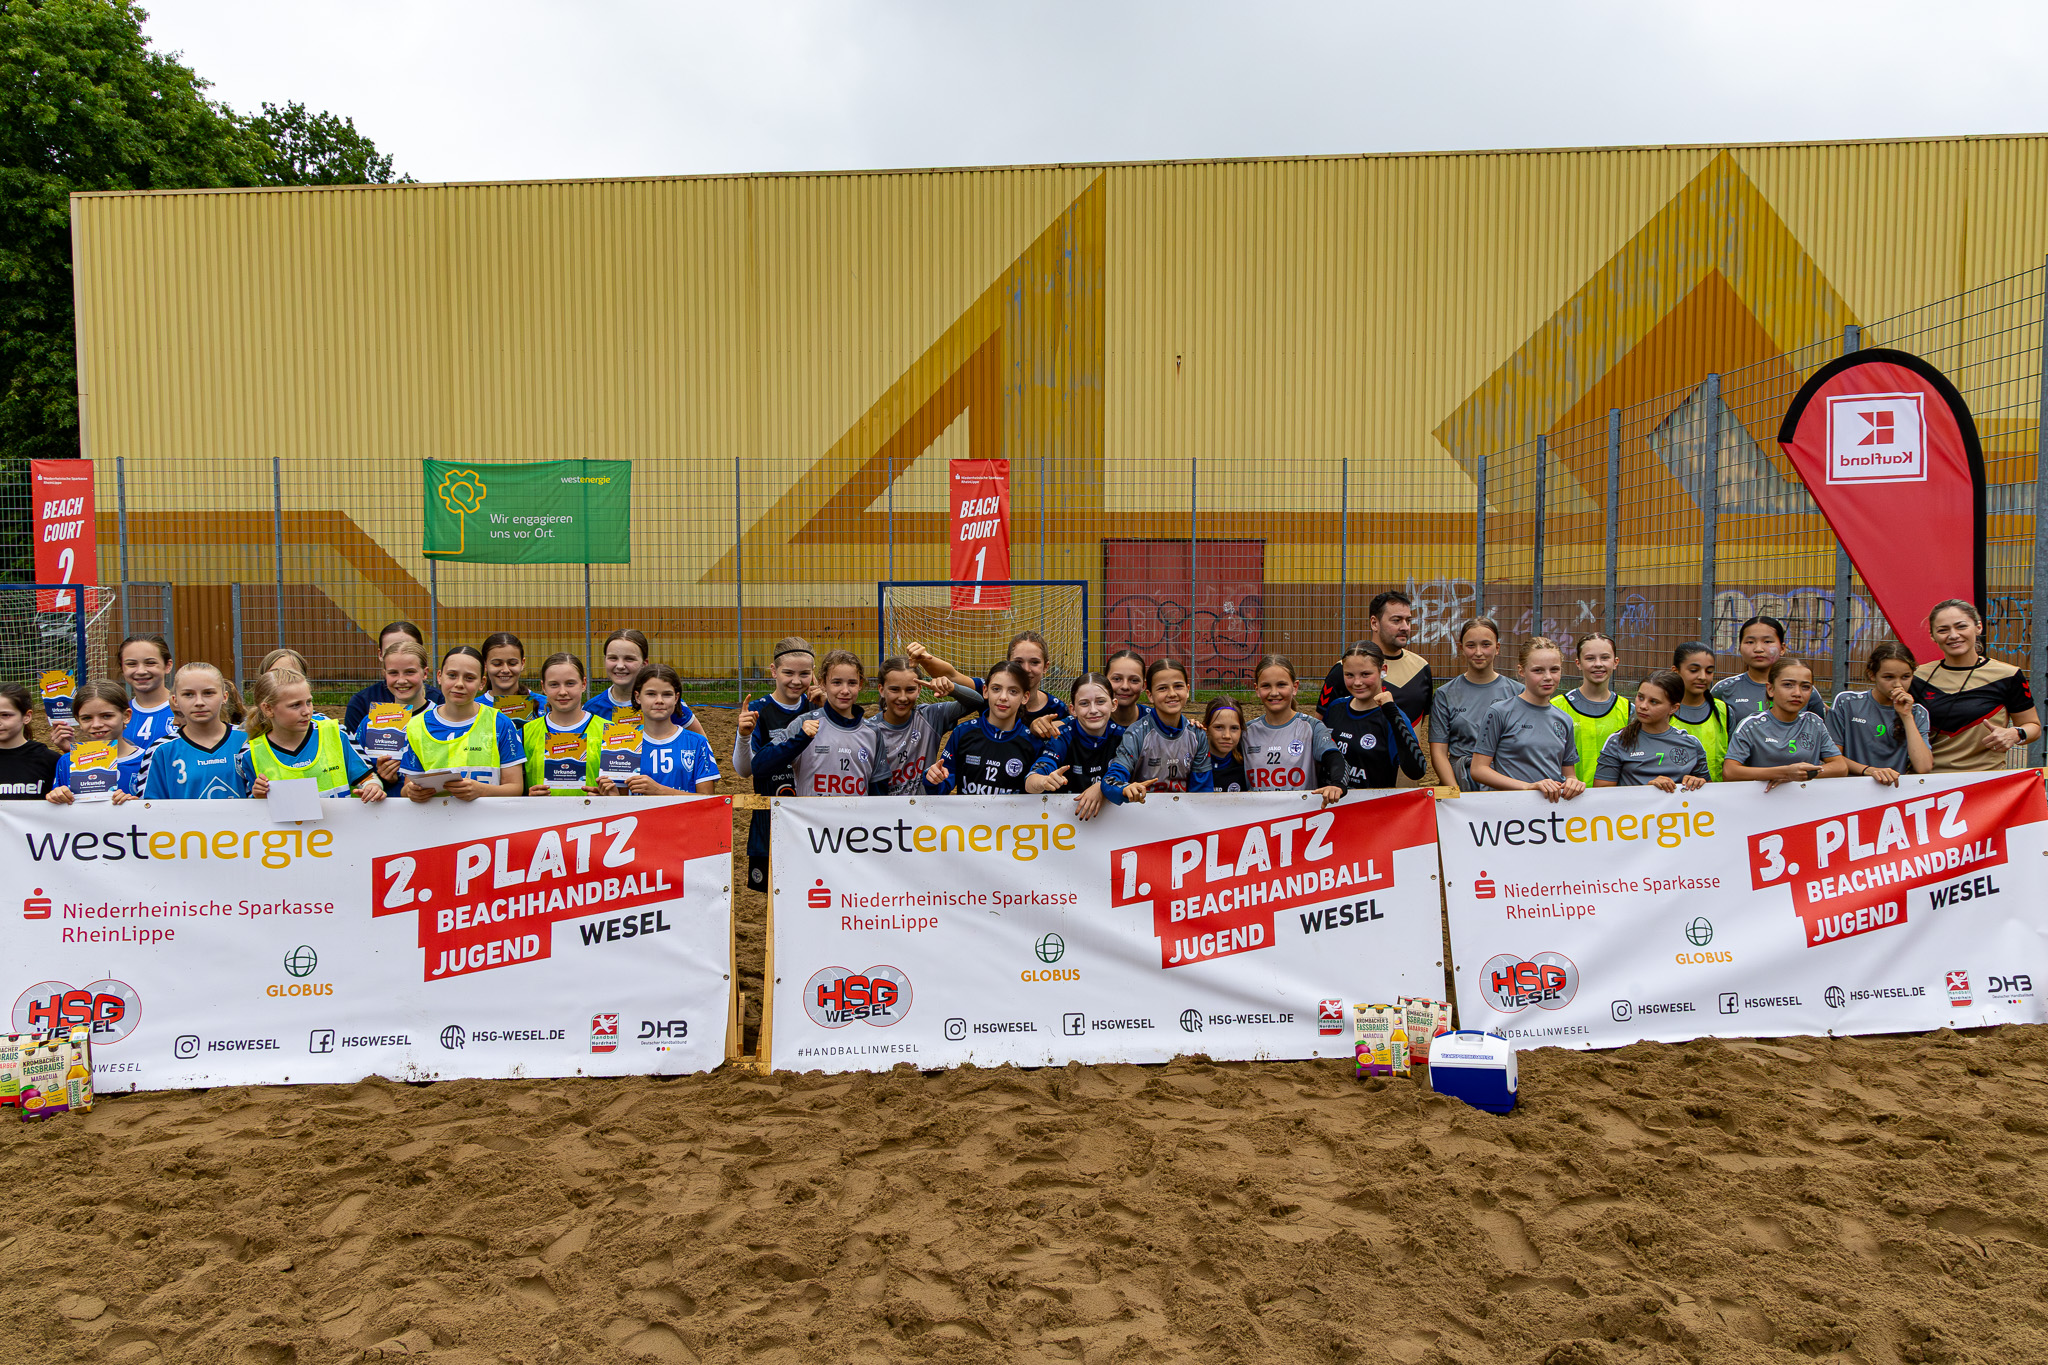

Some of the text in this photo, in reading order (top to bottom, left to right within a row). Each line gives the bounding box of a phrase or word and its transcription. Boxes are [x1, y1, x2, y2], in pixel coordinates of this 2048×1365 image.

[561, 475, 611, 486] westenergie
[42, 497, 84, 520] BEACH
[960, 496, 1000, 519] BEACH
[490, 513, 573, 526] Wir engagieren
[43, 520, 85, 543] COURT
[490, 527, 556, 539] uns vor Ort.
[960, 519, 1001, 542] COURT
[56, 548, 75, 607] 2
[973, 546, 987, 605] 1
[137, 716, 154, 740] 4
[1874, 724, 1886, 737] 9
[1337, 741, 1348, 754] 28
[1788, 740, 1797, 754] 5
[197, 757, 228, 765] hummel
[650, 749, 674, 774] 15
[840, 759, 850, 771] 12
[898, 751, 908, 764] 29
[1267, 752, 1281, 765] 22
[1656, 752, 1664, 766] 7
[172, 759, 187, 785] 3
[888, 756, 926, 787] RGO
[985, 766, 998, 781] 12
[1168, 765, 1177, 778] 10
[1246, 767, 1306, 788] ERGO
[0, 780, 42, 794] mmel
[813, 774, 867, 796] ERGO
[1469, 801, 1715, 848] westenergie
[25, 820, 334, 869] westenergie
[808, 813, 1076, 861] westenergie
[1759, 790, 1968, 882] 3. PLATZ
[383, 816, 639, 909] 2. PLATZ
[1120, 811, 1336, 901] 1. PLATZ
[1806, 837, 1997, 903] BEACHHANDBALL
[1170, 858, 1383, 923] BEACHHANDBALL
[1504, 875, 1721, 898] Niederrheinische Sparkasse
[1929, 874, 2000, 910] WESEL
[437, 869, 672, 933] BEACHHANDBALL
[841, 890, 1078, 908] Niederrheinische Sparkasse
[63, 899, 334, 919] Niederrheinische Sparkasse
[1300, 898, 1384, 935] WESEL
[1506, 904, 1596, 920] RheinLippe
[579, 909, 671, 946] WESEL
[841, 915, 939, 932] RheinLippe
[1812, 901, 1899, 942] JUGEND
[62, 926, 175, 944] RheinLippe
[1168, 923, 1265, 964] JUGEND
[431, 934, 541, 976] JUGEND
[1676, 951, 1733, 965] GLOBUS
[1020, 968, 1081, 983] GLOBUS
[1491, 962, 1567, 996] HSG
[1988, 974, 2032, 993] DHB
[266, 983, 333, 998] GLOBUS
[817, 975, 899, 1011] HSG
[1501, 989, 1560, 1008] WESEL
[1850, 986, 1926, 1000] HSG-WESEL.DE
[28, 990, 125, 1029] HSG
[1638, 1002, 1696, 1014] HSGWESEL
[1744, 996, 1802, 1008] HSGWESEL
[825, 1004, 891, 1023] WESEL
[1208, 1012, 1295, 1026] HSG-WESEL.DE
[1407, 1017, 1433, 1027] SSBRAUSE
[637, 1020, 688, 1038] DHB
[973, 1021, 1037, 1034] HSGWESEL
[1091, 1018, 1155, 1031] HSGWESEL
[1356, 1023, 1389, 1031] FASSBRAUSE
[1497, 1026, 1589, 1039] NDBALLINWESEL
[341, 1035, 412, 1048] HSGWESEL
[472, 1029, 566, 1042] HSG-WESEL.DE
[208, 1038, 280, 1052] HSGWESEL
[798, 1043, 919, 1057] #HANDBALLINWESEL
[23, 1056, 64, 1067] KROMBACHER'S
[23, 1062, 64, 1075] FASSBRAUSE
[31, 1073, 57, 1082] MARACUJA
